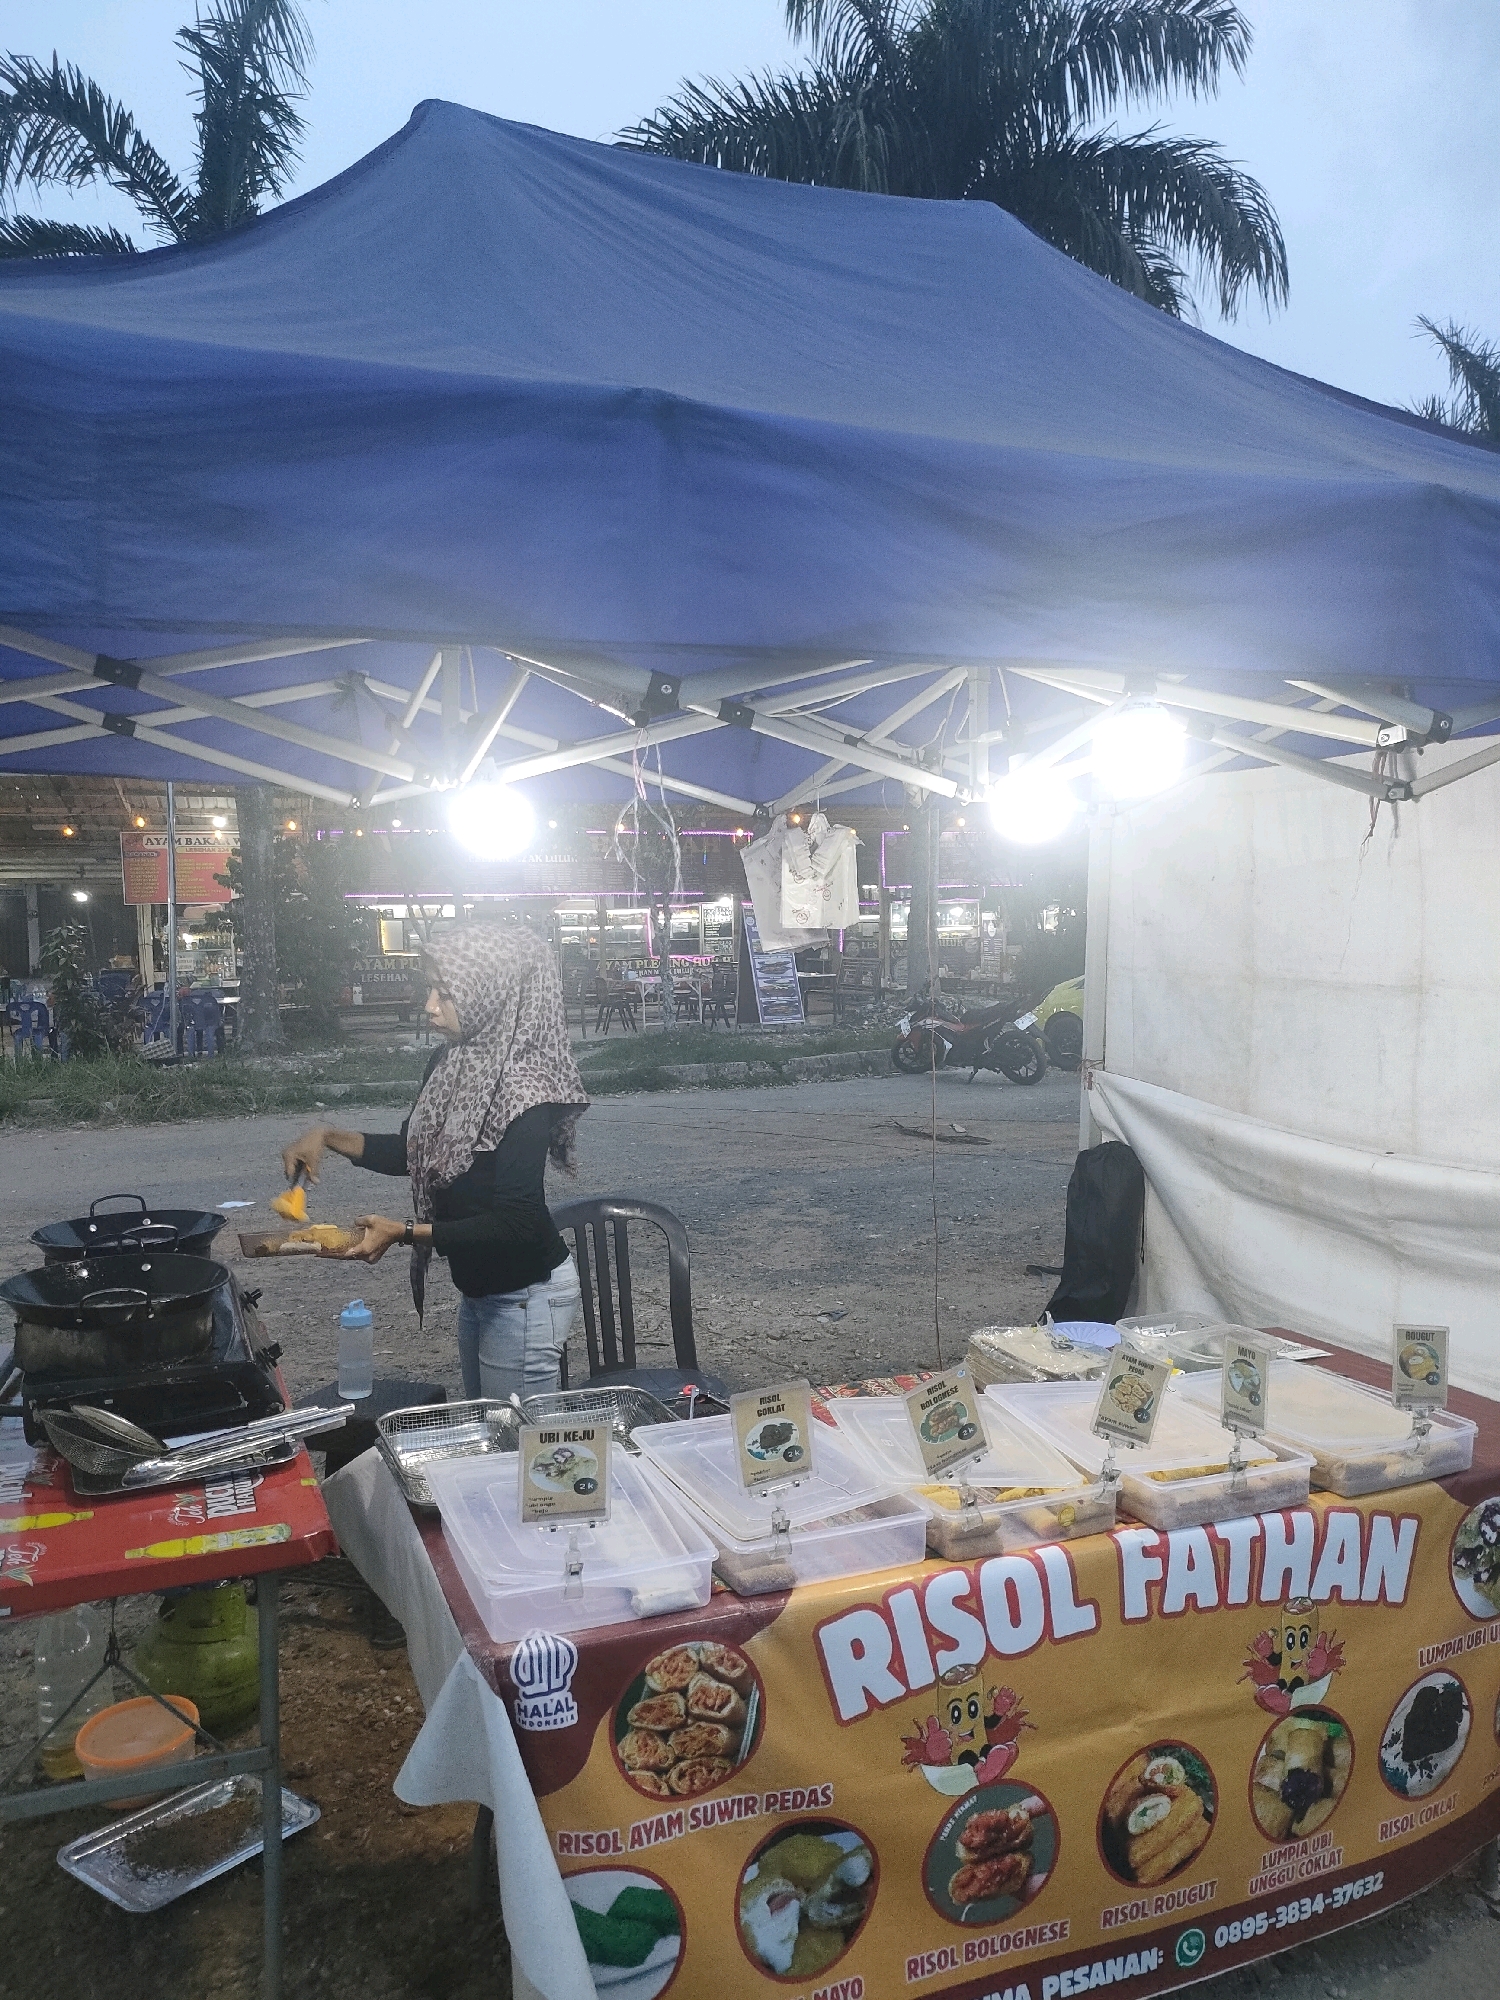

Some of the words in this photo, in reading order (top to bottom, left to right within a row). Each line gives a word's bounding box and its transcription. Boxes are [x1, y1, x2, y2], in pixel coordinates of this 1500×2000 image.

[1237, 1345, 1256, 1360] MAYO
[759, 1393, 782, 1406] RISOL
[920, 1385, 960, 1411] BOLOGNESE
[926, 1380, 948, 1396] RISOL
[539, 1431, 561, 1444] UBI
[563, 1429, 595, 1443] KEJU
[816, 1543, 1099, 1725] RISOL
[1111, 1506, 1421, 1625] FATHAN
[1418, 1636, 1464, 1669] LUMPIA
[1466, 1626, 1487, 1651] UBI
[517, 1714, 576, 1728] INDONESIA
[557, 1830, 624, 1856] RISOL
[628, 1810, 686, 1851] AYAM
[687, 1794, 760, 1831] SUWIR
[763, 1783, 834, 1813] PEDAS
[1379, 1812, 1415, 1842] RISOL
[1418, 1791, 1460, 1826] COKLAT
[1249, 1864, 1298, 1895] UNGGU
[1297, 1848, 1344, 1878] COKLAT
[1260, 1839, 1310, 1871] LUMPIA
[1310, 1830, 1334, 1855] UBI
[1101, 1899, 1152, 1929] RISOL
[1153, 1880, 1219, 1916] ROUGUT
[906, 1947, 960, 1983] RISOL
[962, 1919, 1071, 1964] BOLOGNESE
[1042, 1947, 1165, 2000] PESANAN:
[1214, 1871, 1385, 1949] 0895-3834-37632
